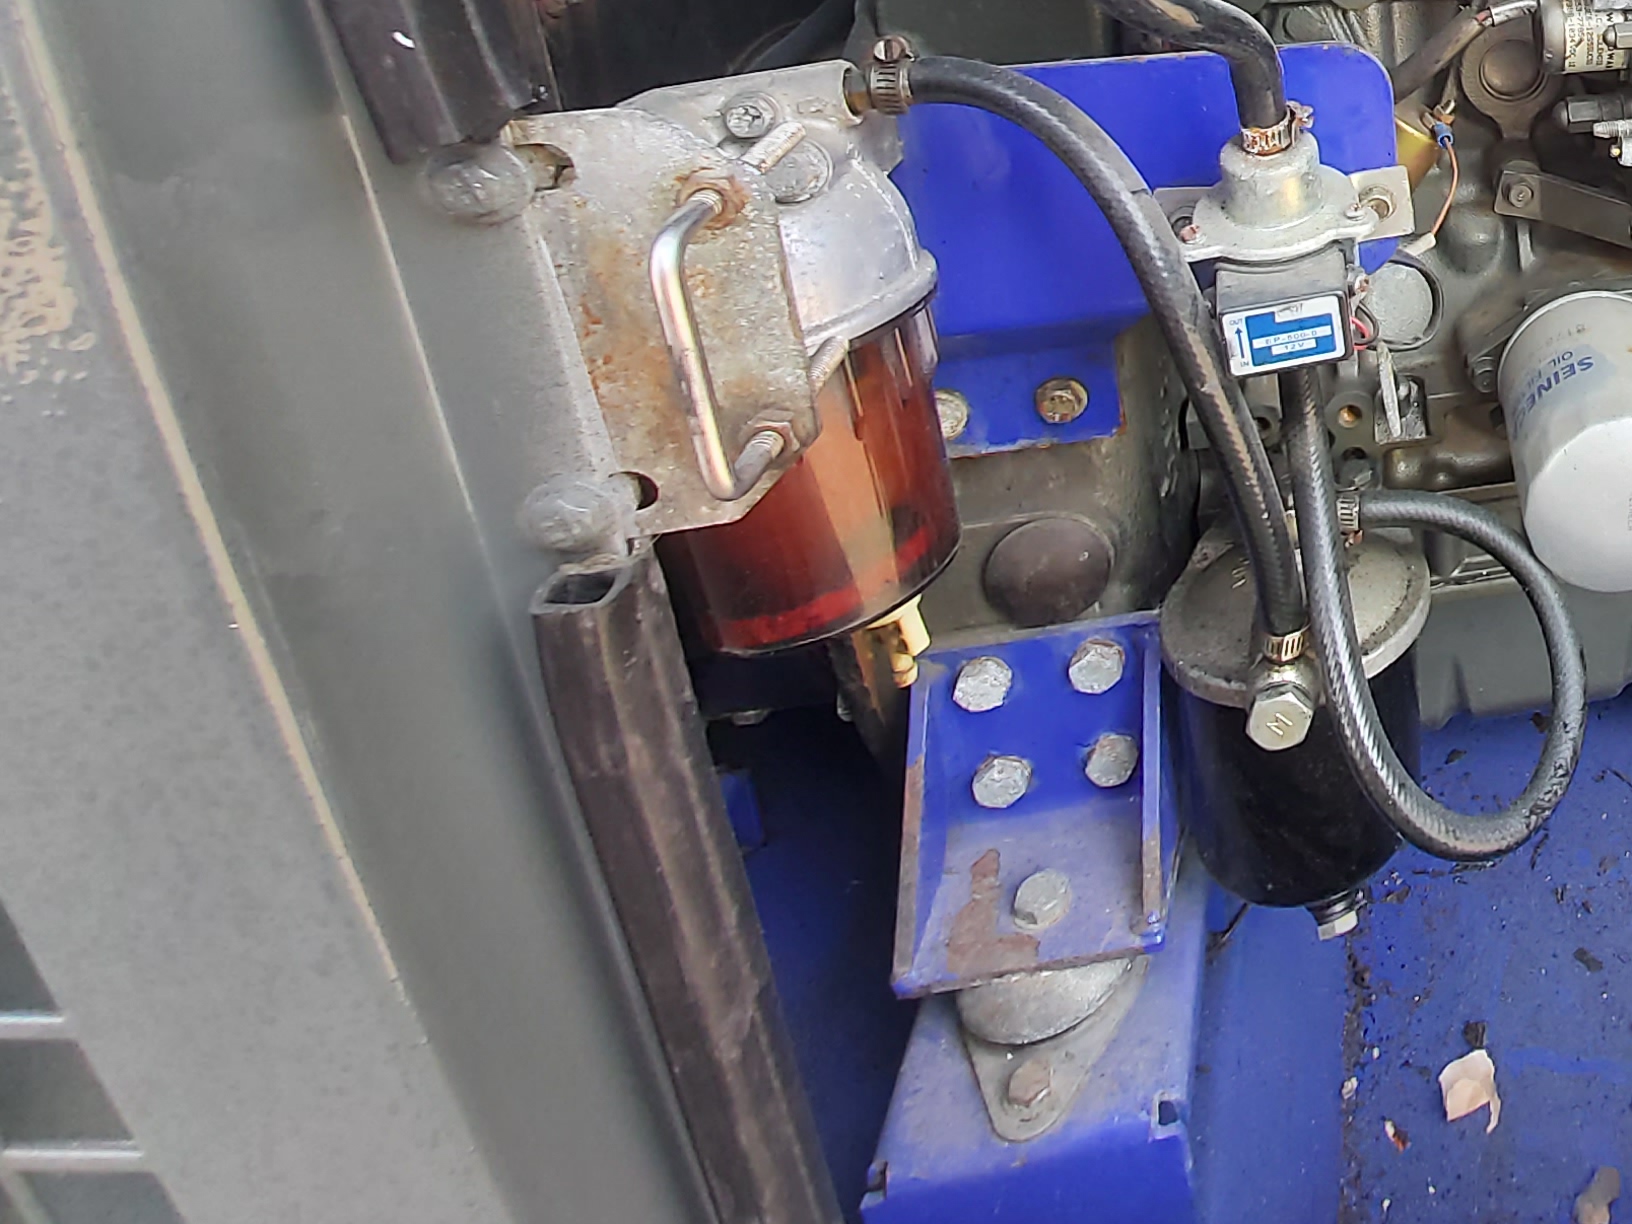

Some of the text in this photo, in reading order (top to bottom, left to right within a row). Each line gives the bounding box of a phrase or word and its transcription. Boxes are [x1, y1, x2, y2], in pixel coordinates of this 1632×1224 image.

[1229, 318, 1243, 326] OUT
[1548, 351, 1573, 367] OIL
[1240, 360, 1250, 368] IN
